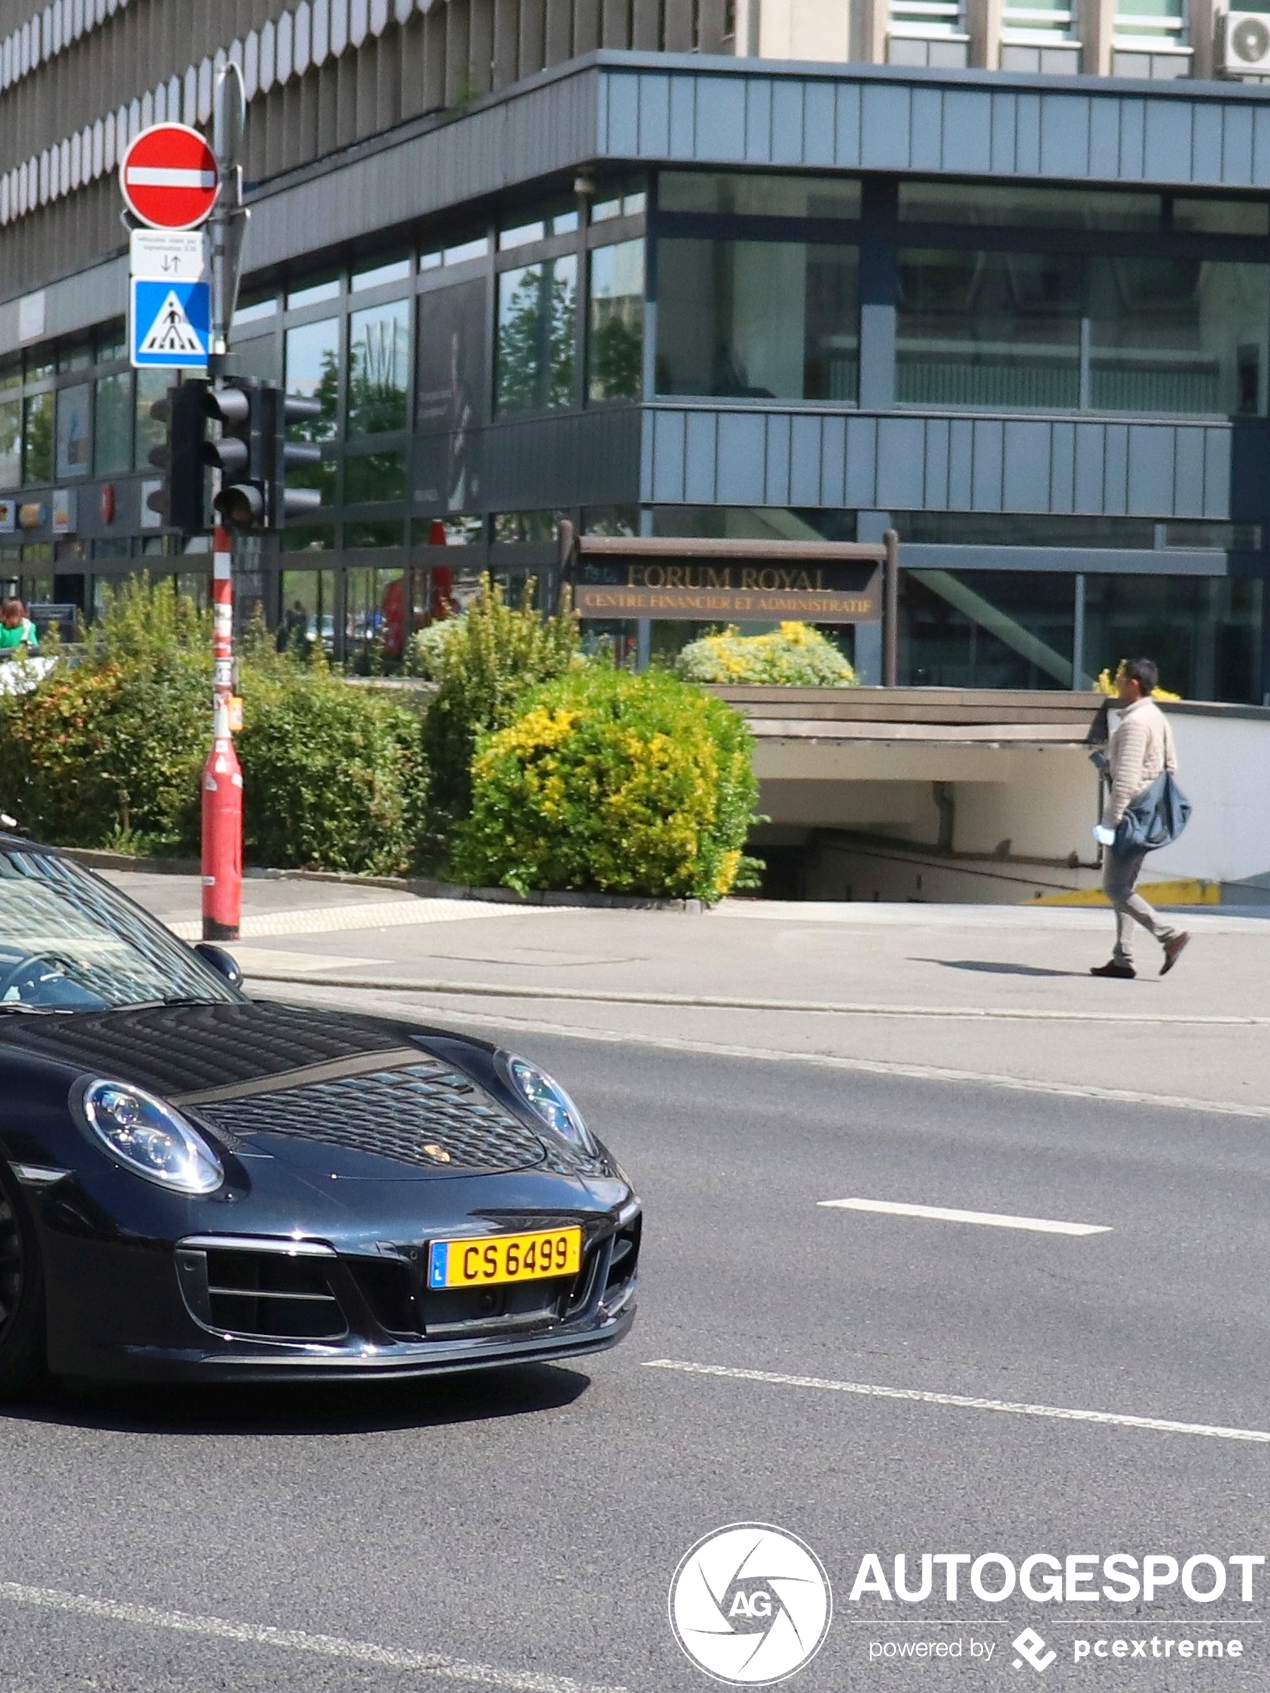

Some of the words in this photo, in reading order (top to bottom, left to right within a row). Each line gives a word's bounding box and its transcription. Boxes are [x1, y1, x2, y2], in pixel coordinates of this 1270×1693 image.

[626, 564, 731, 591] FORUM
[740, 567, 833, 593] ROYAL
[584, 593, 646, 608] CENTRE
[649, 595, 731, 610] FINANCIER
[735, 597, 752, 610] ET
[758, 598, 872, 613] ADMINISTRATIF
[463, 1245, 498, 1280] CS
[506, 1236, 568, 1276] 6499
